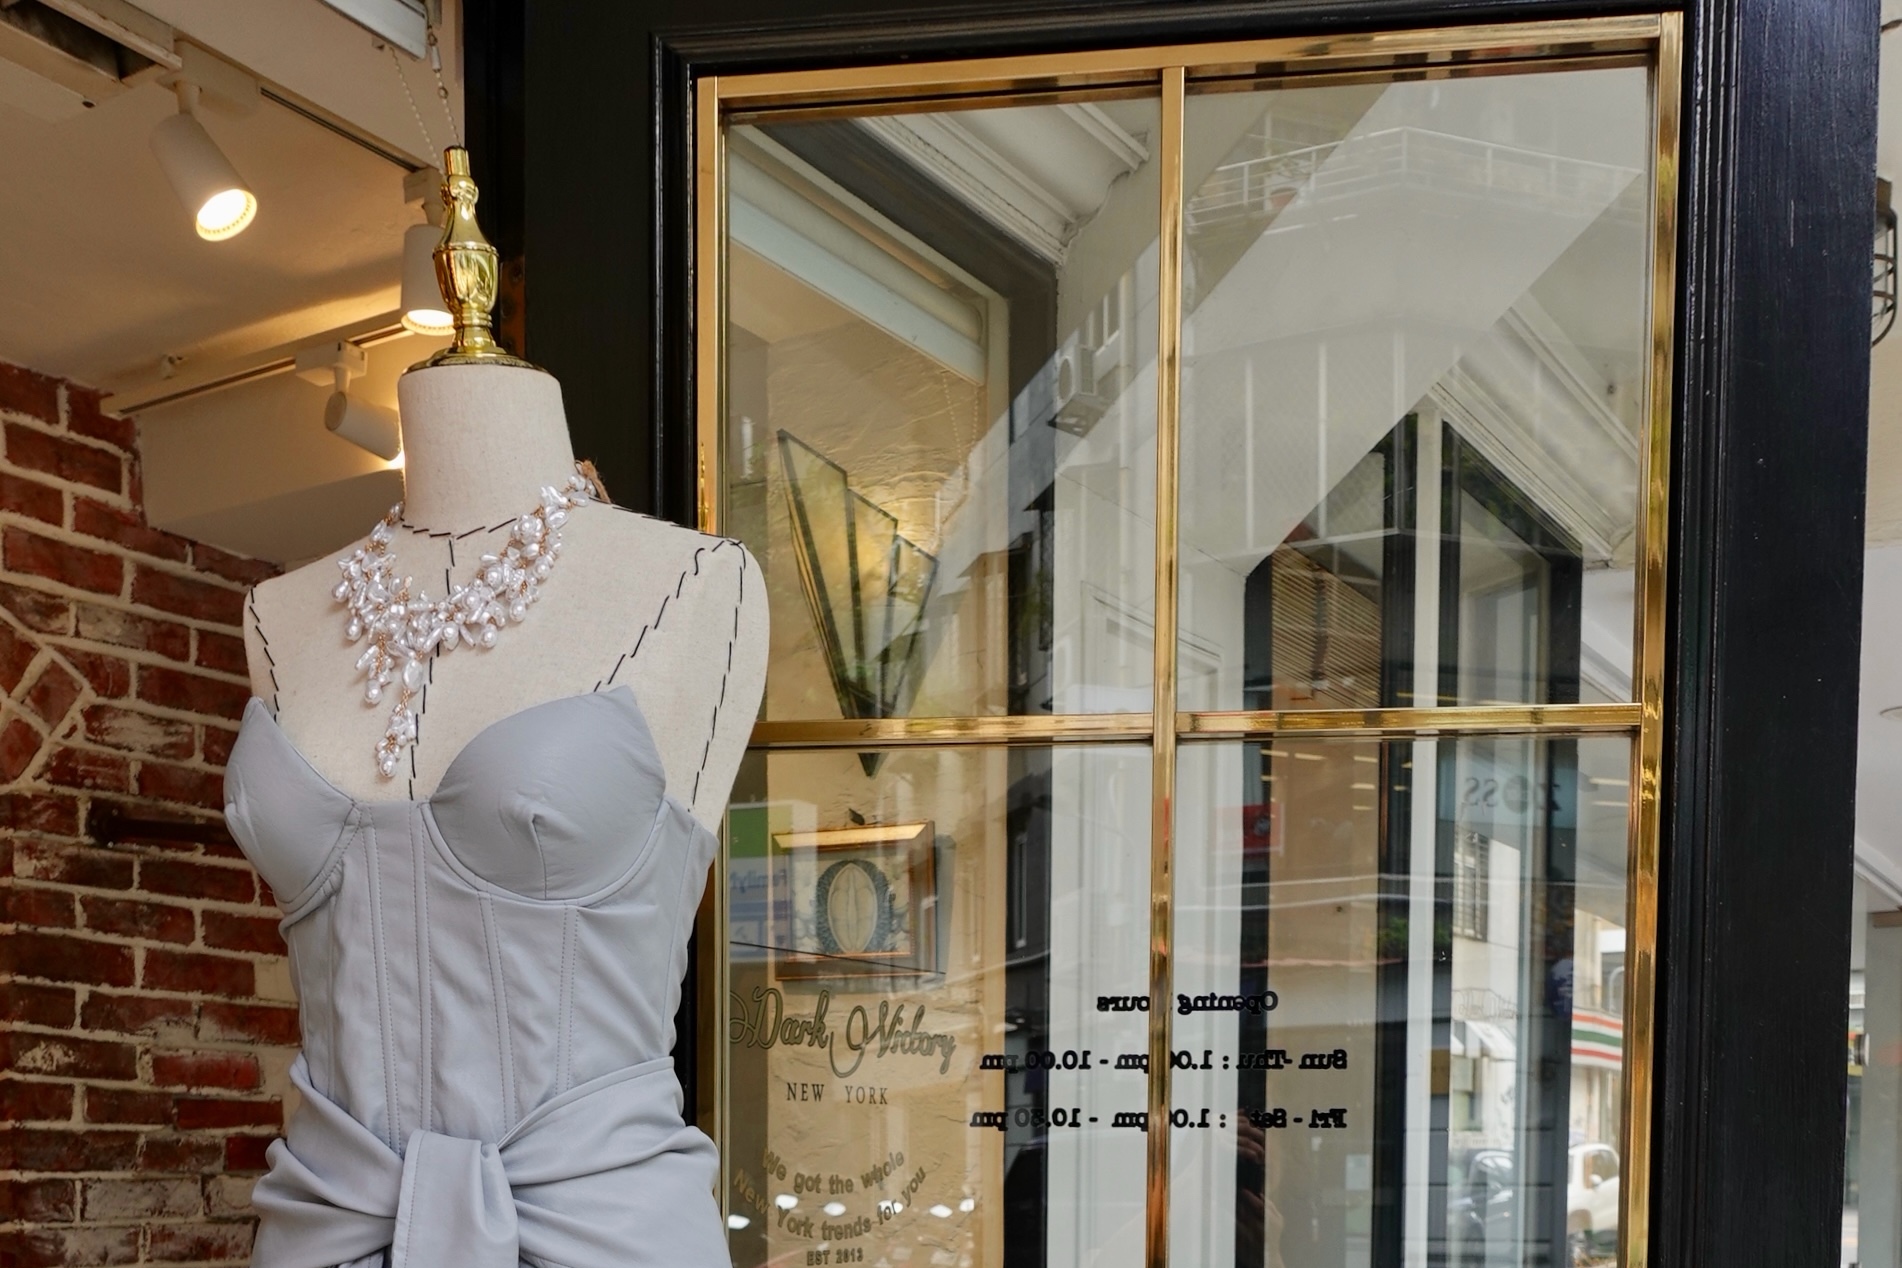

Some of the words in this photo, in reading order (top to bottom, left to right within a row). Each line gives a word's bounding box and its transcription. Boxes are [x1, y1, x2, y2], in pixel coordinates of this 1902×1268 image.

[730, 985, 829, 1050] Dark
[829, 1000, 957, 1078] Victory
[787, 1082, 825, 1102] NEW
[845, 1085, 888, 1105] YORK
[762, 1149, 787, 1182] We
[793, 1171, 822, 1194] got
[828, 1174, 854, 1195] the
[860, 1151, 905, 1189] whole
[733, 1168, 771, 1215] New
[774, 1204, 814, 1239] York
[821, 1215, 872, 1241] trends
[876, 1199, 898, 1226] for
[901, 1166, 927, 1208] you
[806, 1250, 830, 1266] EST
[835, 1248, 865, 1264] 2013
